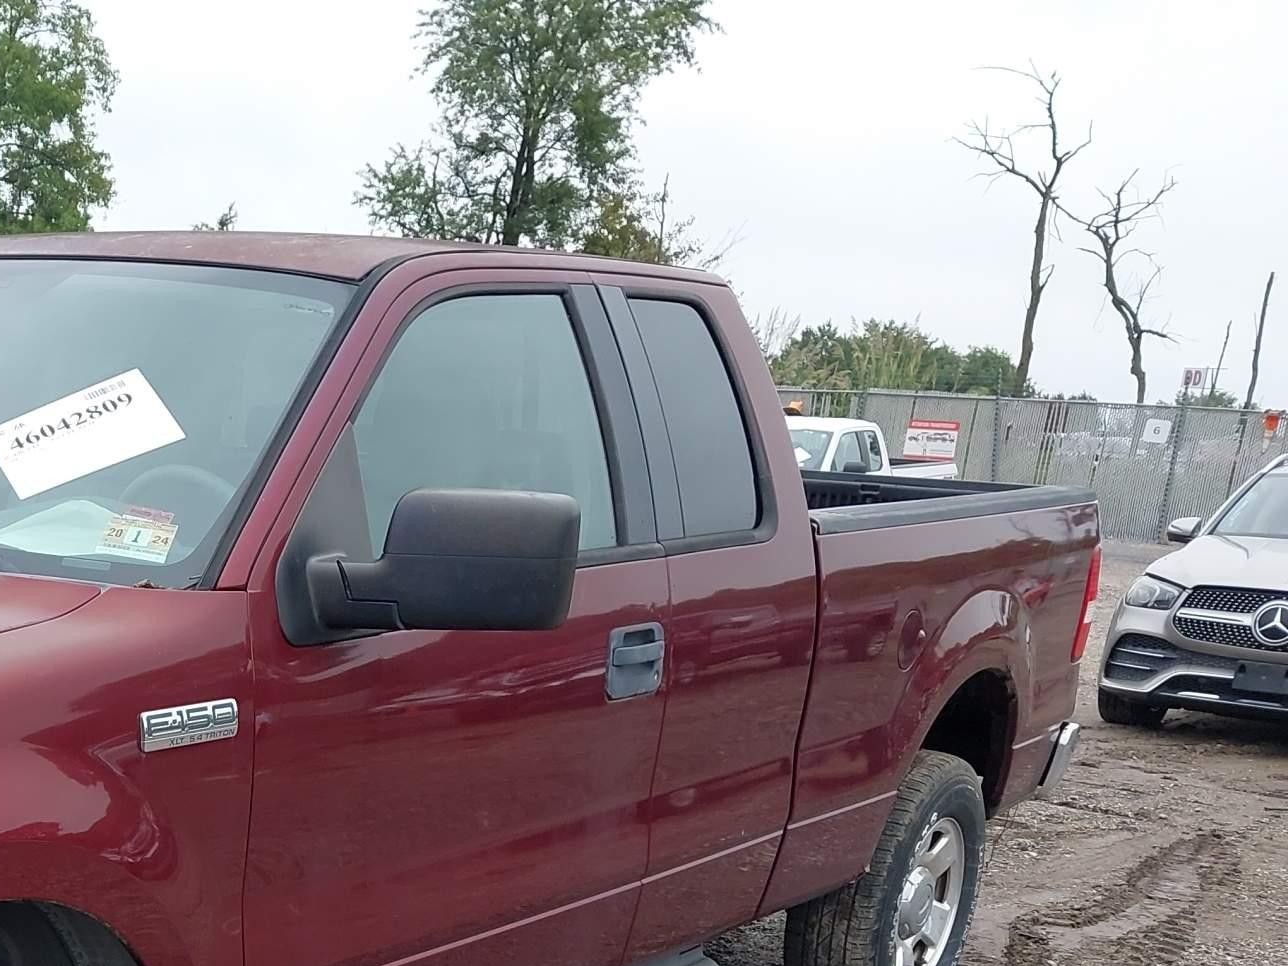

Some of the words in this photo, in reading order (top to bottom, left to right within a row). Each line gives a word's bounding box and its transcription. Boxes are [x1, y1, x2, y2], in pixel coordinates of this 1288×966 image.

[10, 392, 133, 450] 46042809
[1153, 427, 1161, 435] 6
[107, 528, 123, 537] 20
[131, 530, 142, 543] 1
[152, 535, 169, 545] 24
[169, 737, 184, 746] XLT
[207, 728, 235, 739] TRITON
